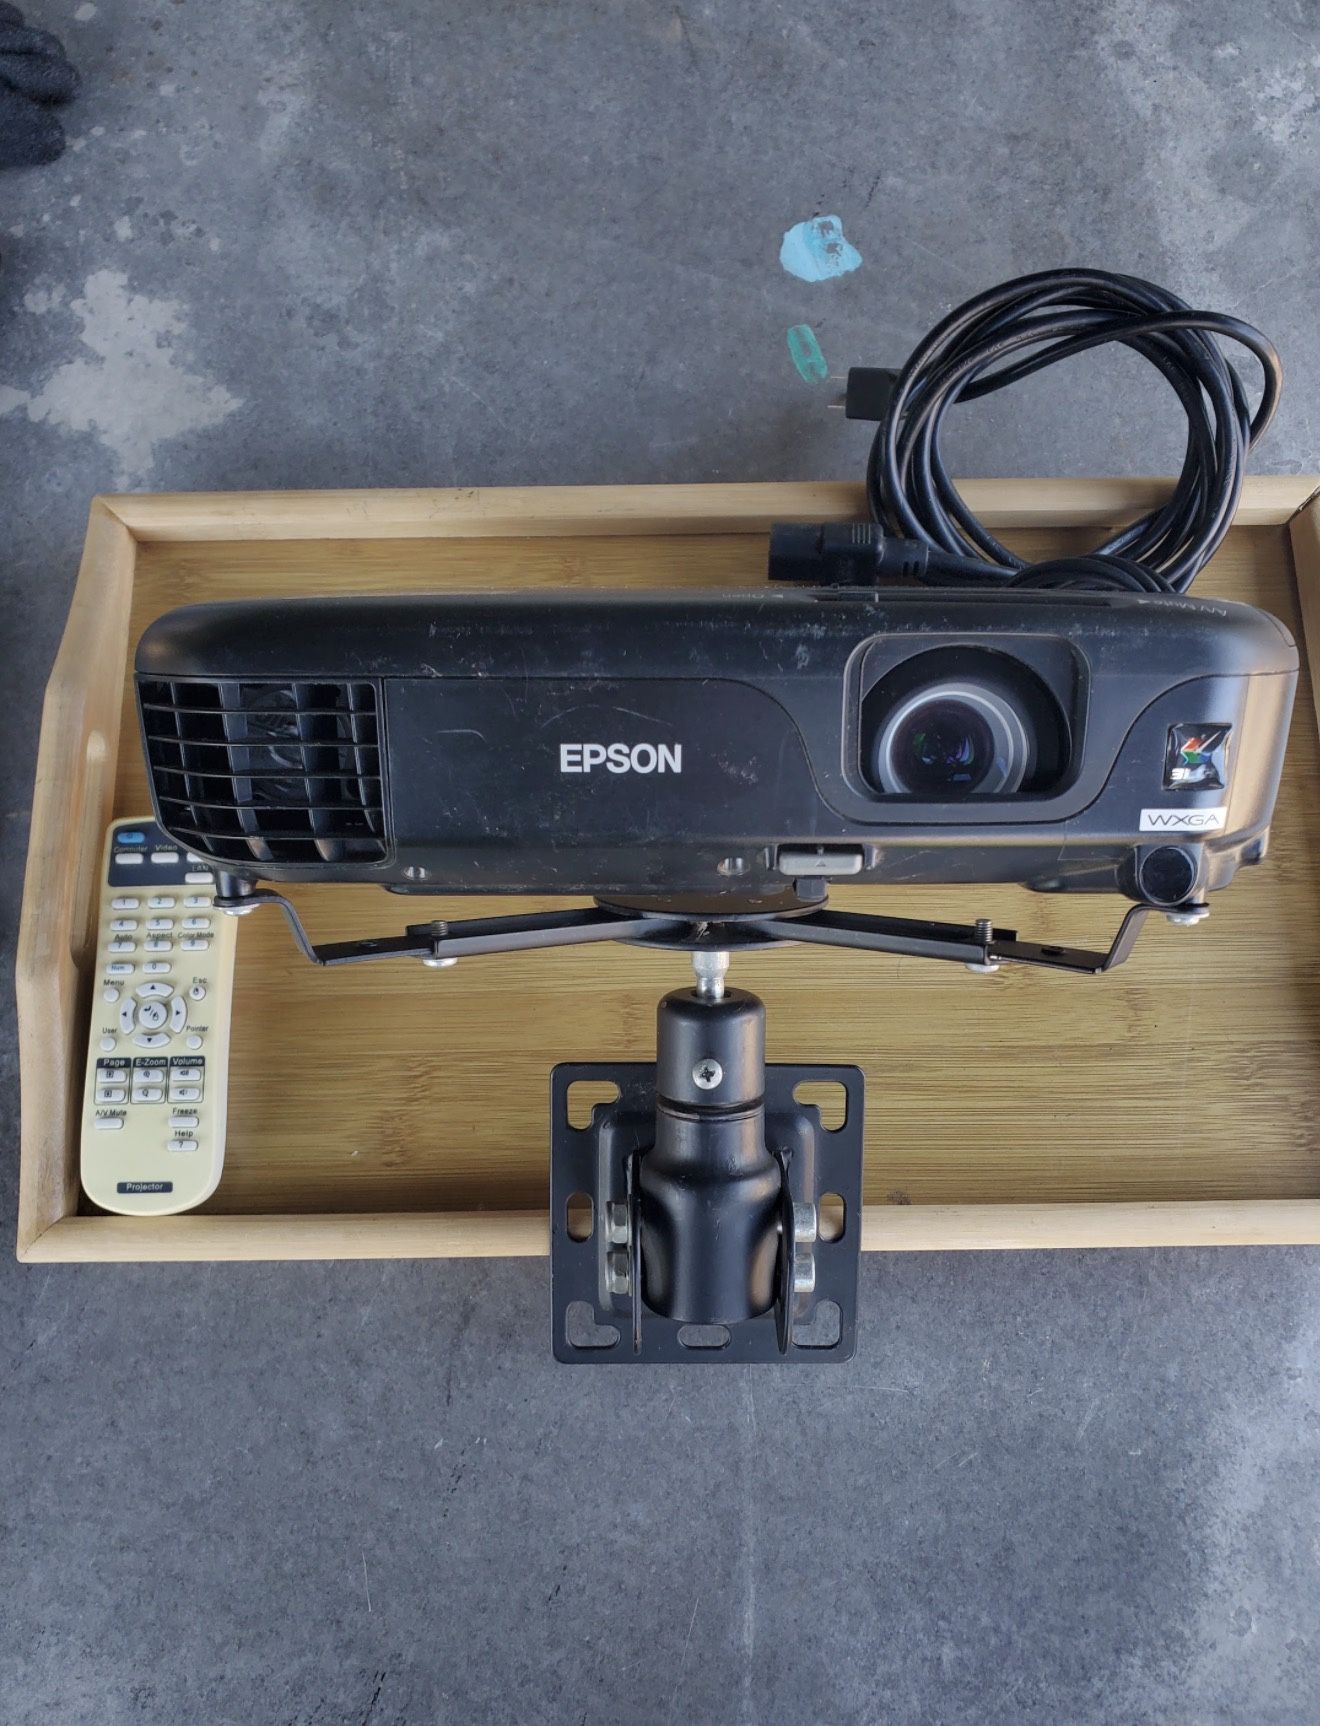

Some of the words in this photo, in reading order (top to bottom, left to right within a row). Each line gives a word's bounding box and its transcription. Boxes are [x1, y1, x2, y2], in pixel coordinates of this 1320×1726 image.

[560, 743, 682, 773] EPSON
[1148, 814, 1219, 826] WXGA
[146, 931, 173, 939] Aspect
[103, 1059, 125, 1067] Page
[135, 1058, 166, 1066] E-Zoom
[174, 1130, 194, 1138] Help
[126, 1182, 164, 1191] Projector
